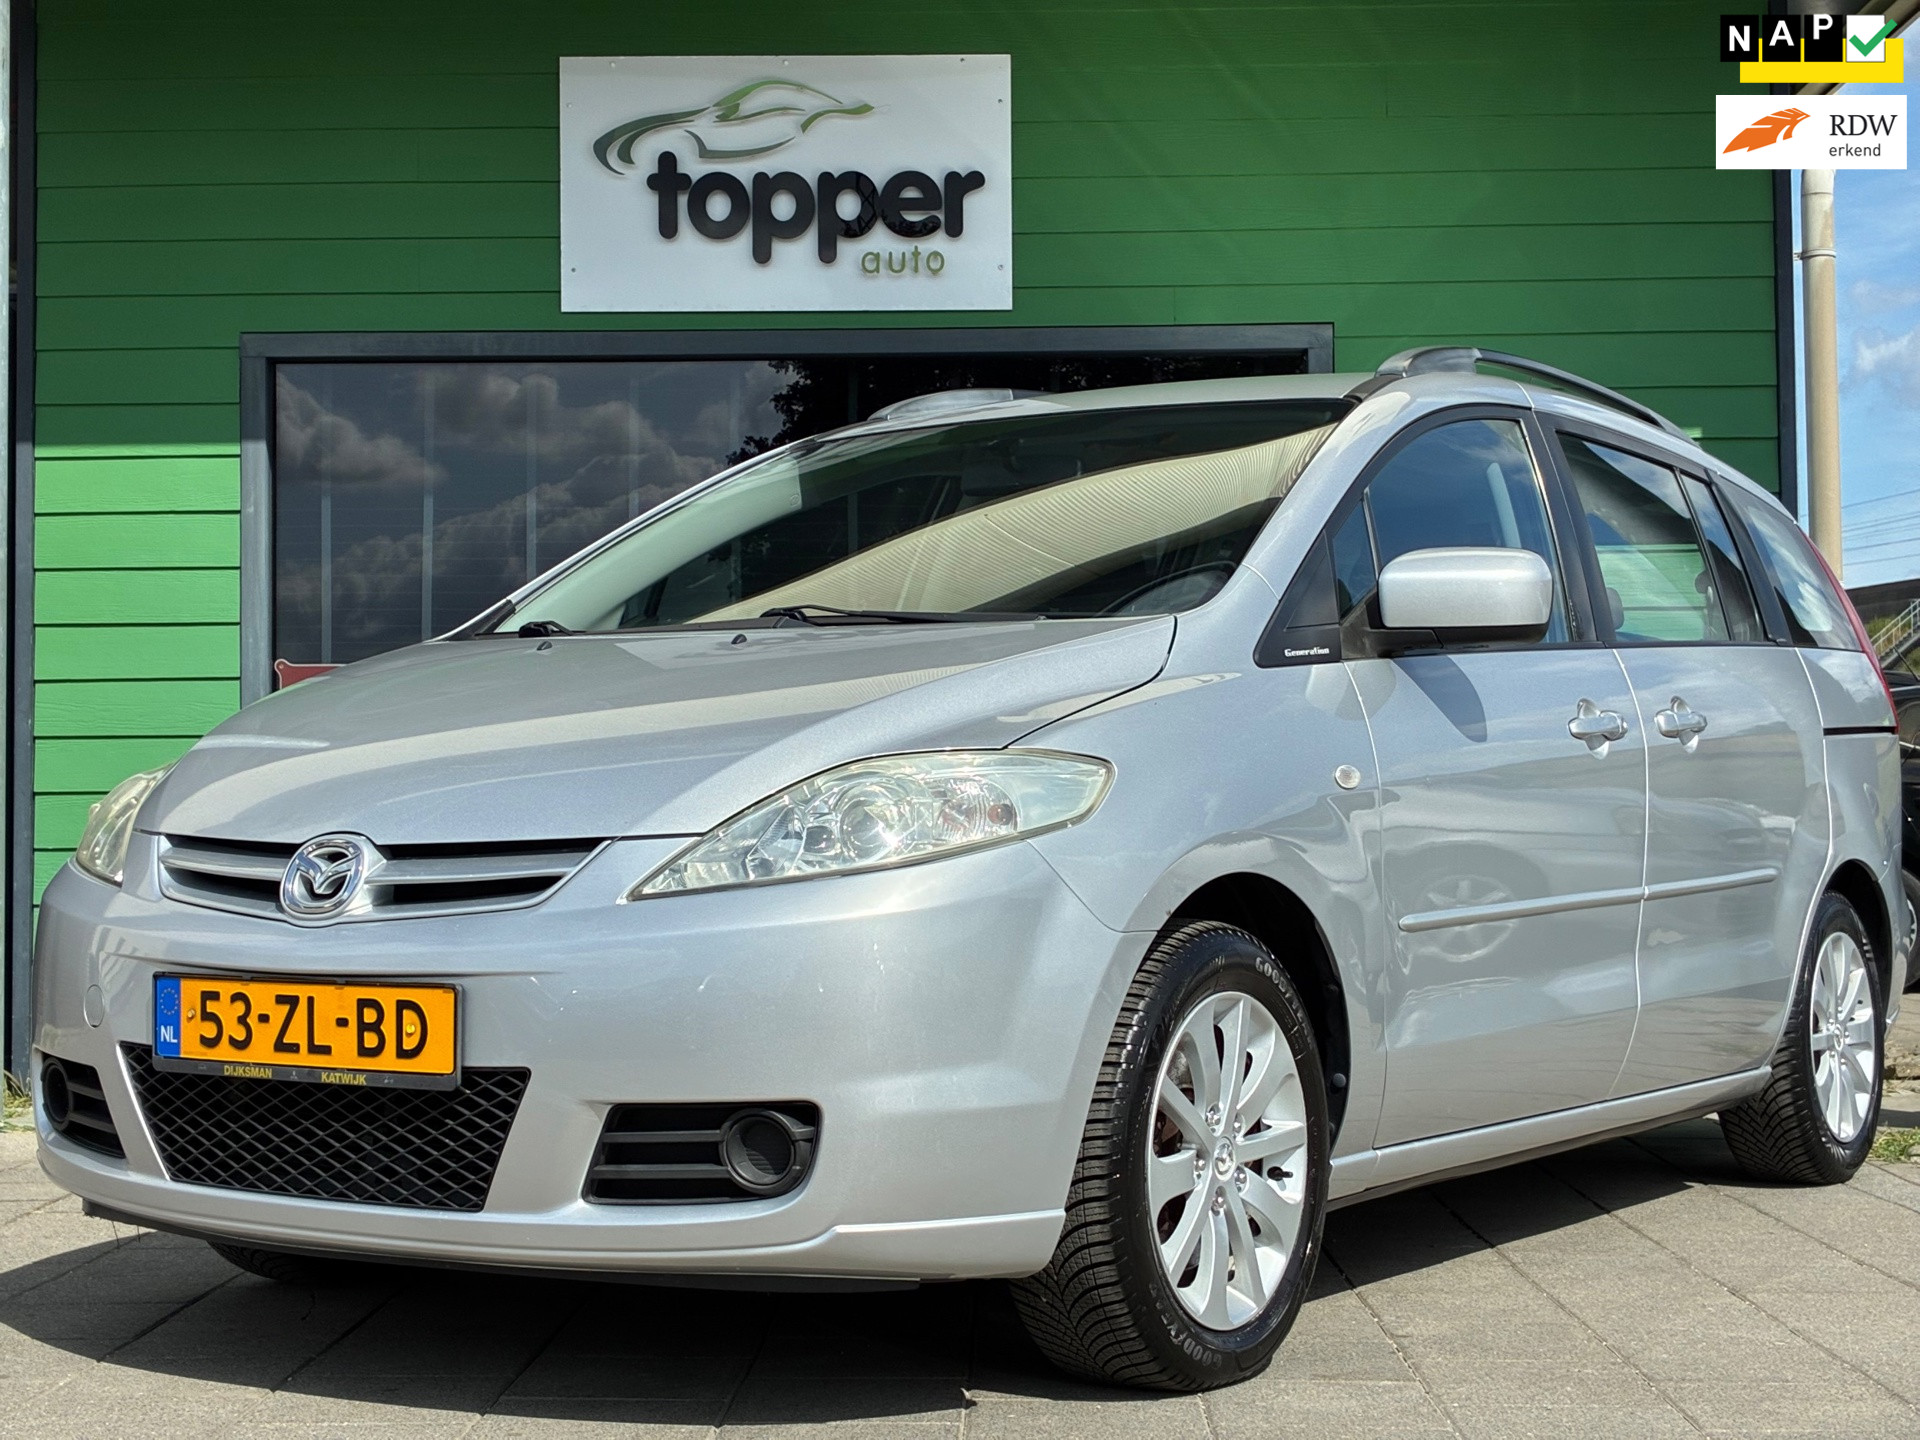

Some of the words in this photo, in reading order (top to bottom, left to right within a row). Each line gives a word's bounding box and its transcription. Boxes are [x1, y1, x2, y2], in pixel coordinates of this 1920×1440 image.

[646, 150, 986, 264] topper
[860, 245, 945, 275] auto
[1284, 647, 1330, 658] Generation
[160, 1026, 177, 1043] NL
[199, 990, 428, 1059] 53-ZL-BD
[223, 1065, 273, 1079] DIJKSMAN
[320, 1071, 367, 1085] KATWIJK
